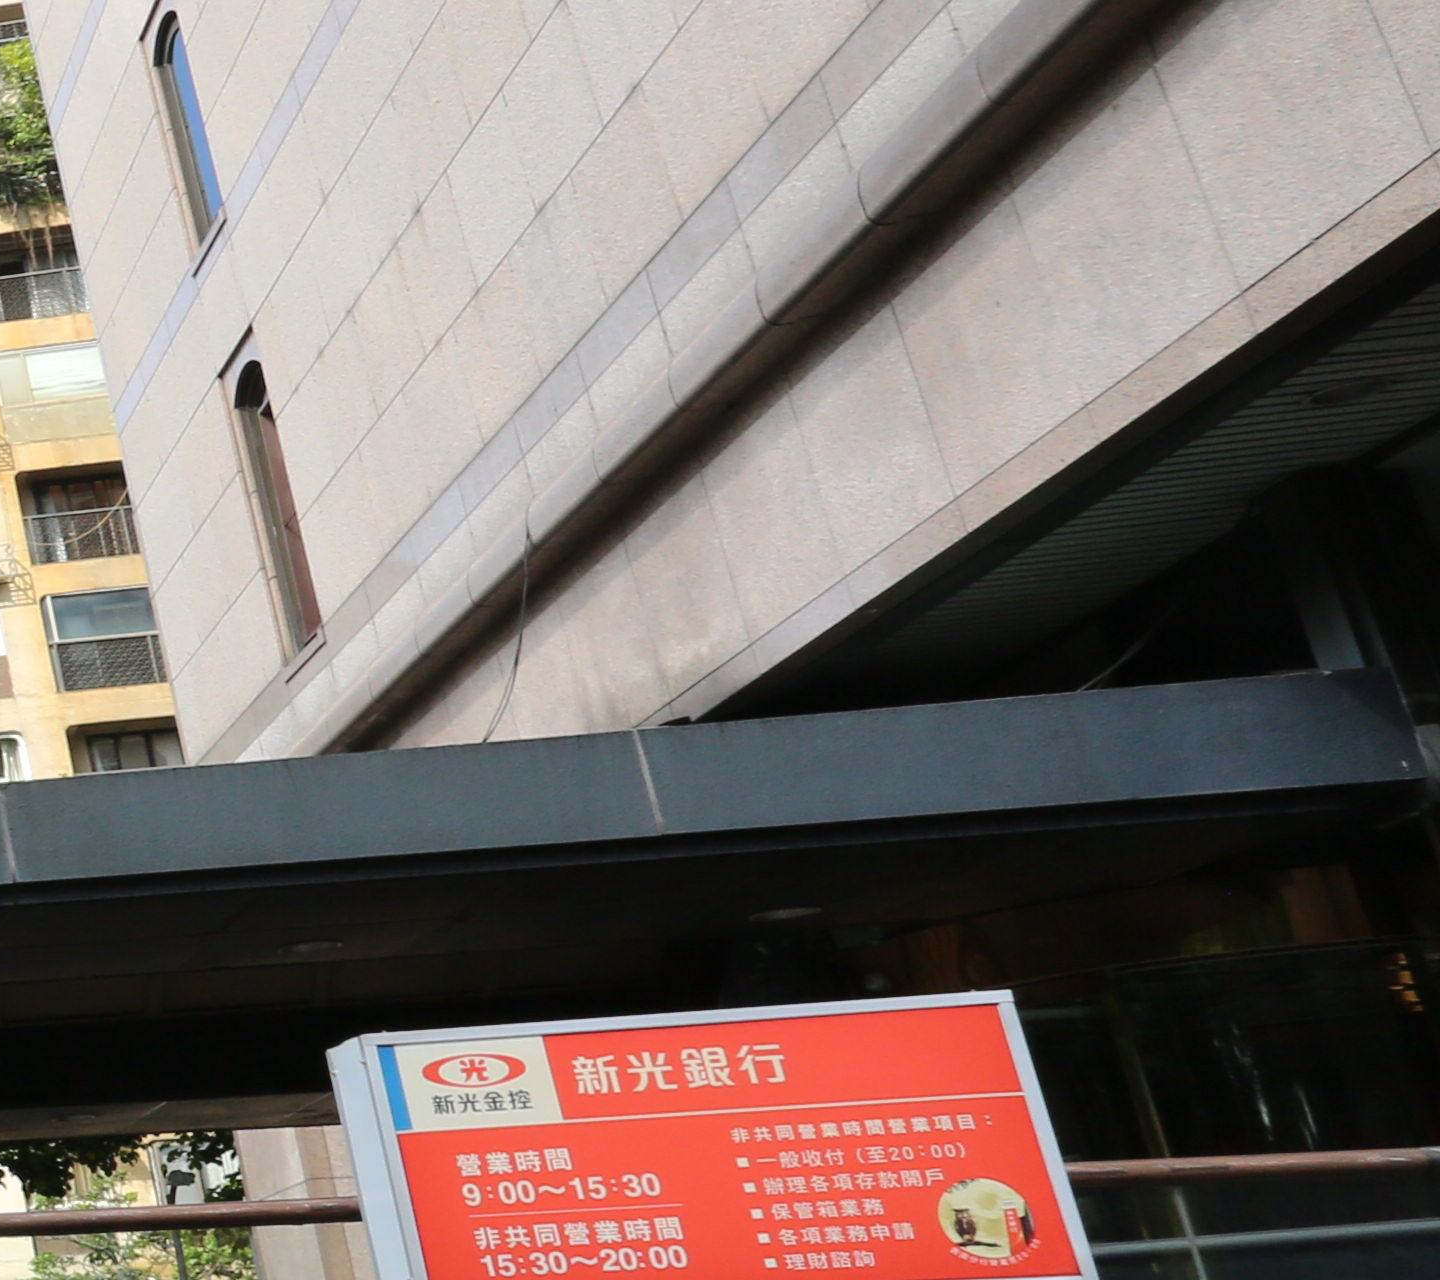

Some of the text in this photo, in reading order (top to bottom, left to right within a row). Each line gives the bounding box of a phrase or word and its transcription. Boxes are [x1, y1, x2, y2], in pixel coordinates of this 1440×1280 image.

[571, 1043, 787, 1096] 新光銀行
[432, 1089, 534, 1115] 新光金控
[456, 1147, 573, 1177] 營業時間
[762, 1168, 946, 1195] 辦理各項存款開戶
[770, 1197, 885, 1221] 保管箱業務
[474, 1216, 685, 1250] 非共同營業時間
[778, 1222, 916, 1246] 各項業務申請
[784, 1250, 876, 1271] 理財諮詢
